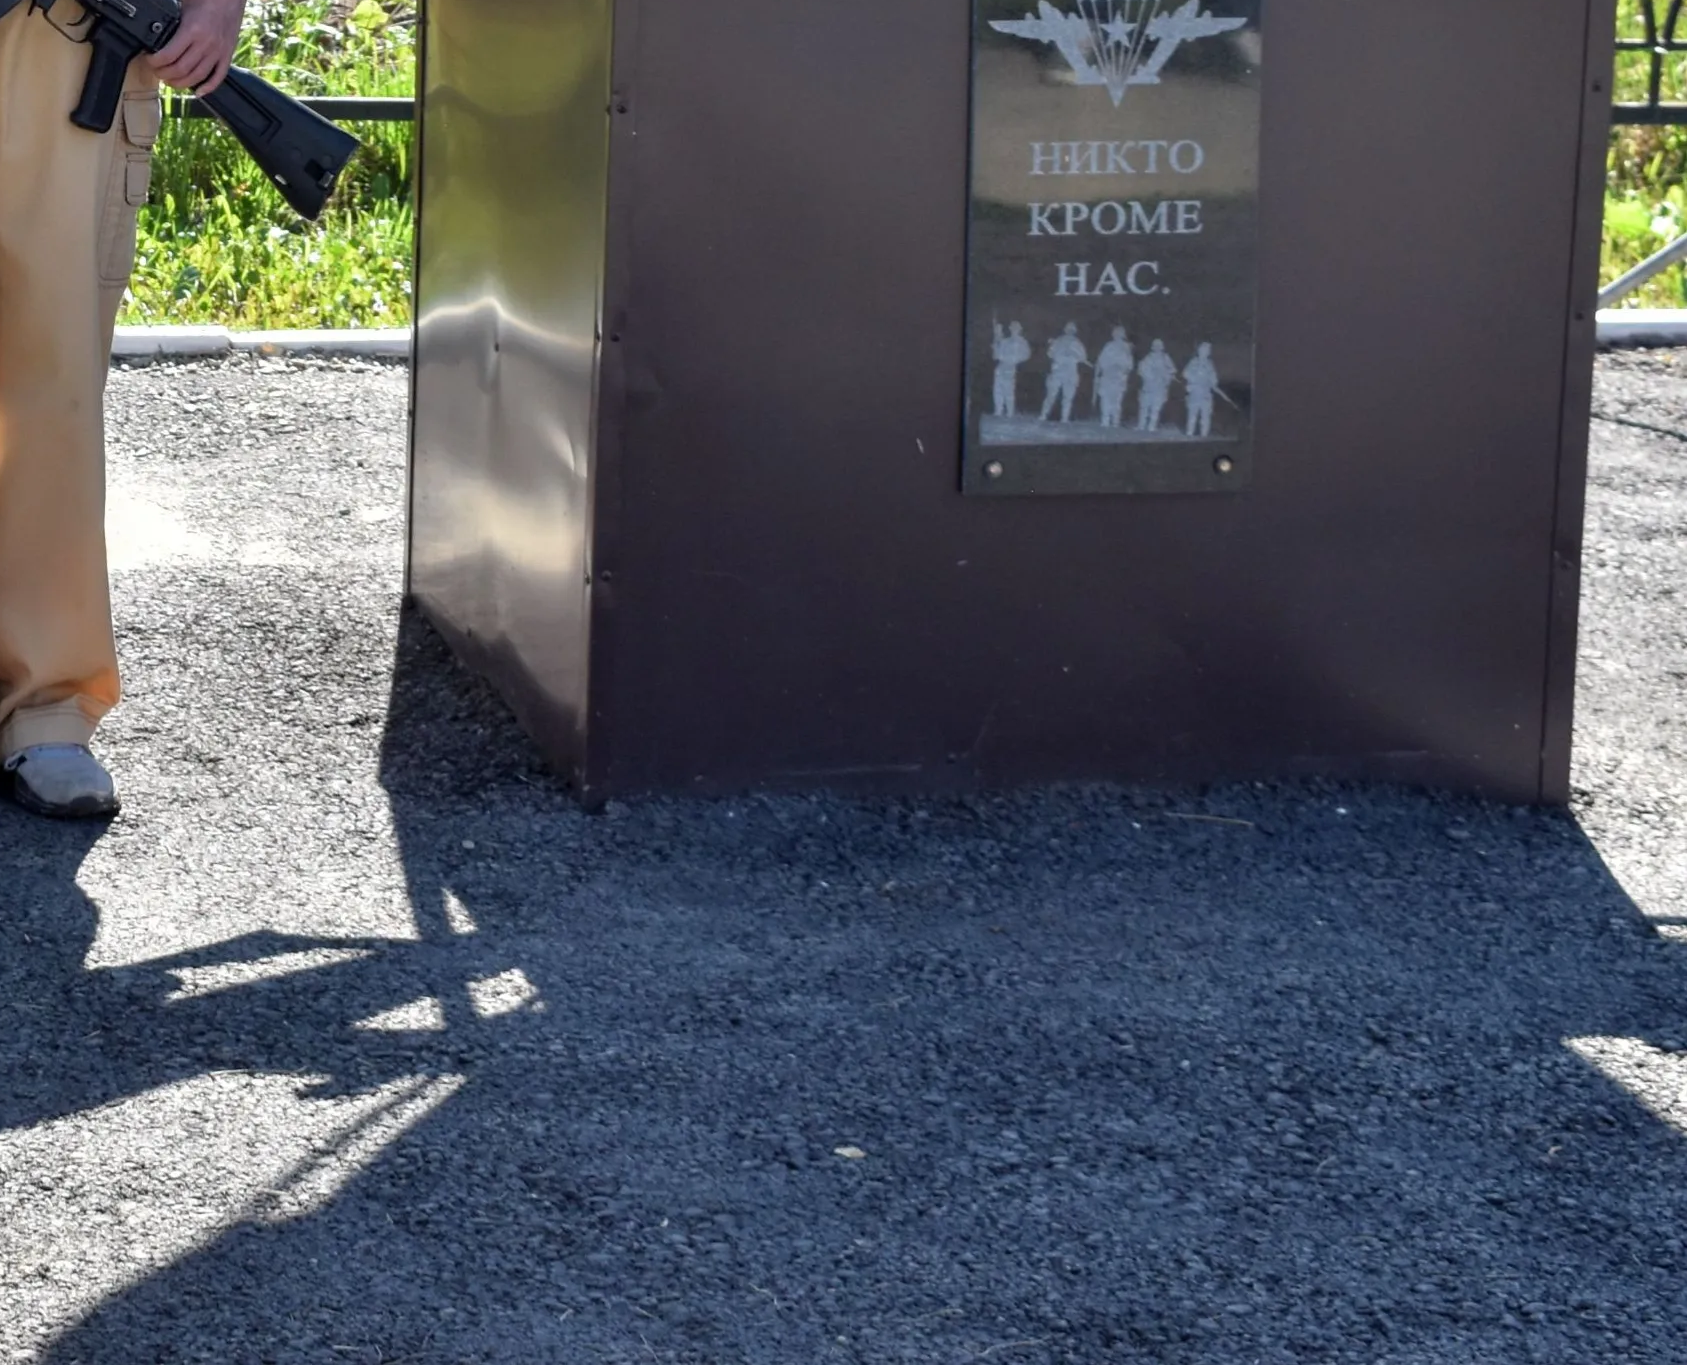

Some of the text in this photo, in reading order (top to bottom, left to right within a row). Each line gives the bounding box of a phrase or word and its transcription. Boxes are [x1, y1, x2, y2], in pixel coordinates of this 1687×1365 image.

[1028, 139, 1205, 175] НИКТО
[1026, 200, 1204, 236] КРОМЕ
[1054, 260, 1171, 296] НАС.
